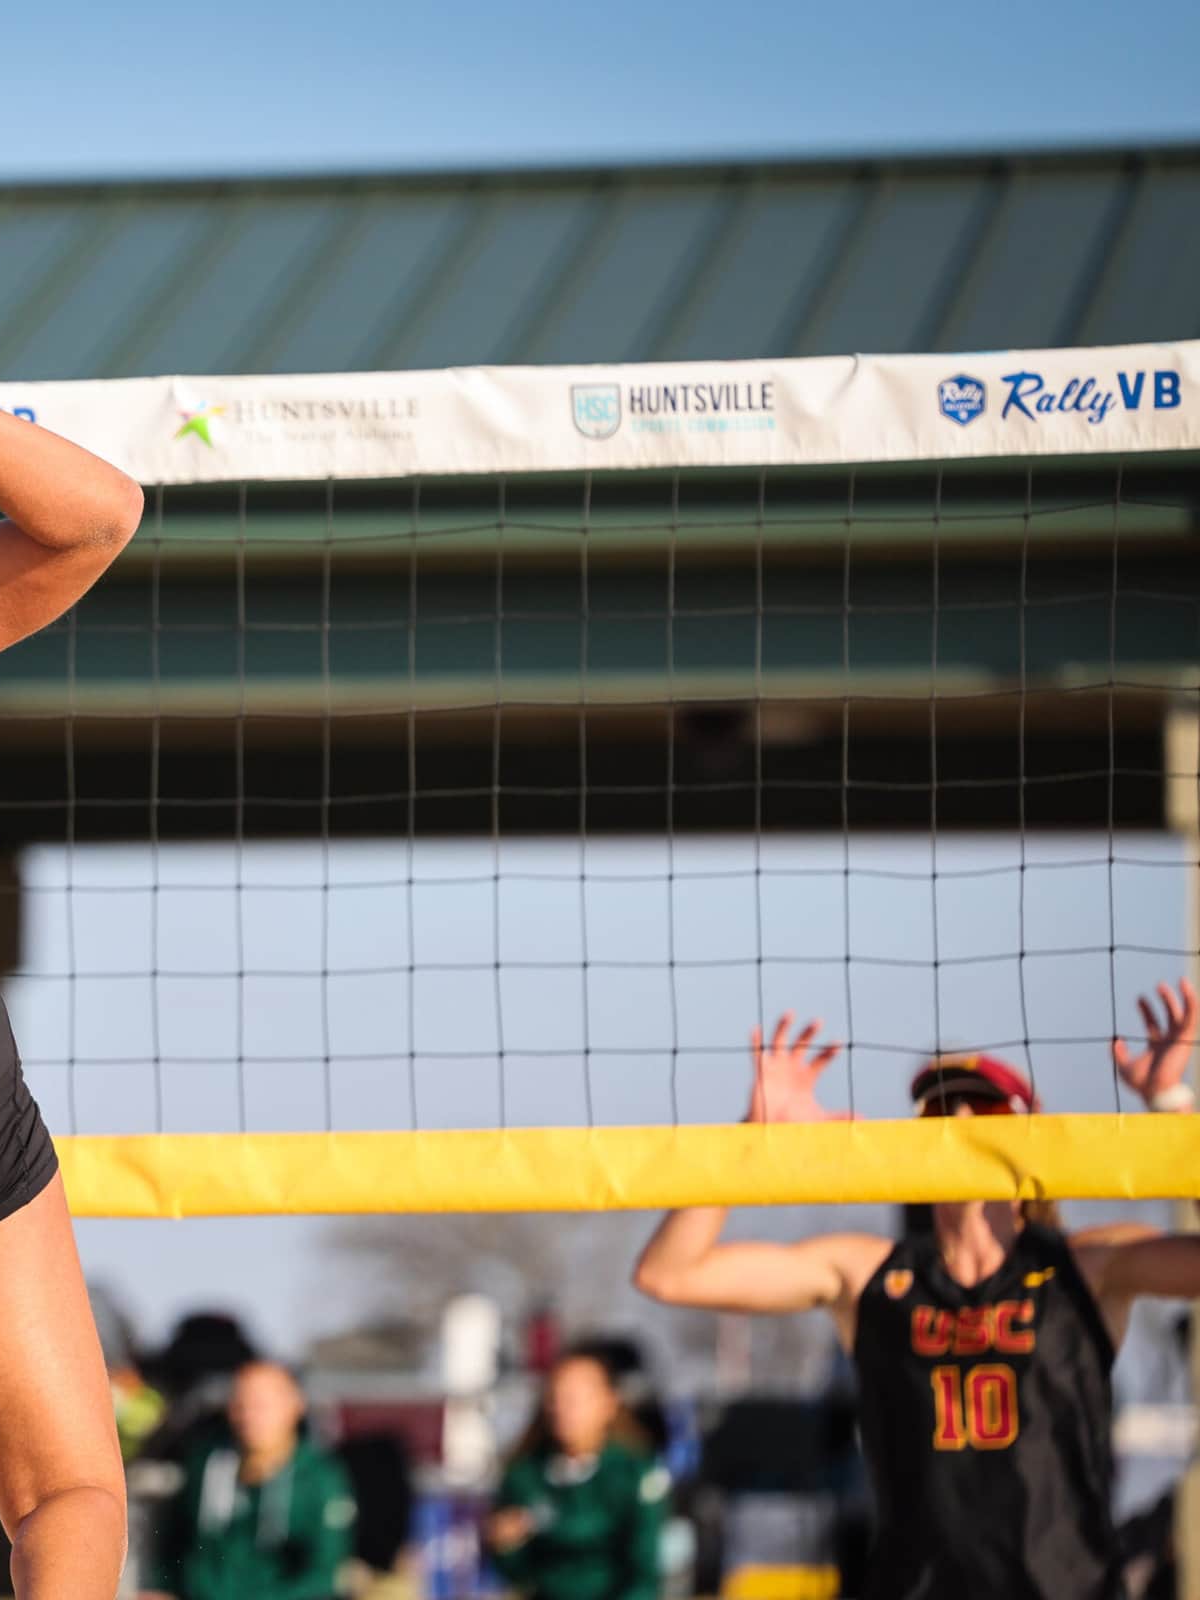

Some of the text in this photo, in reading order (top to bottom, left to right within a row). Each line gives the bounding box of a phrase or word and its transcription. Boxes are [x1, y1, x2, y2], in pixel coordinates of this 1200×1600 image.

[234, 397, 420, 424] HUNTSVILLE
[629, 381, 775, 414] HUNTSVILLE
[911, 1299, 1036, 1356] USC
[930, 1363, 1019, 1451] 10
